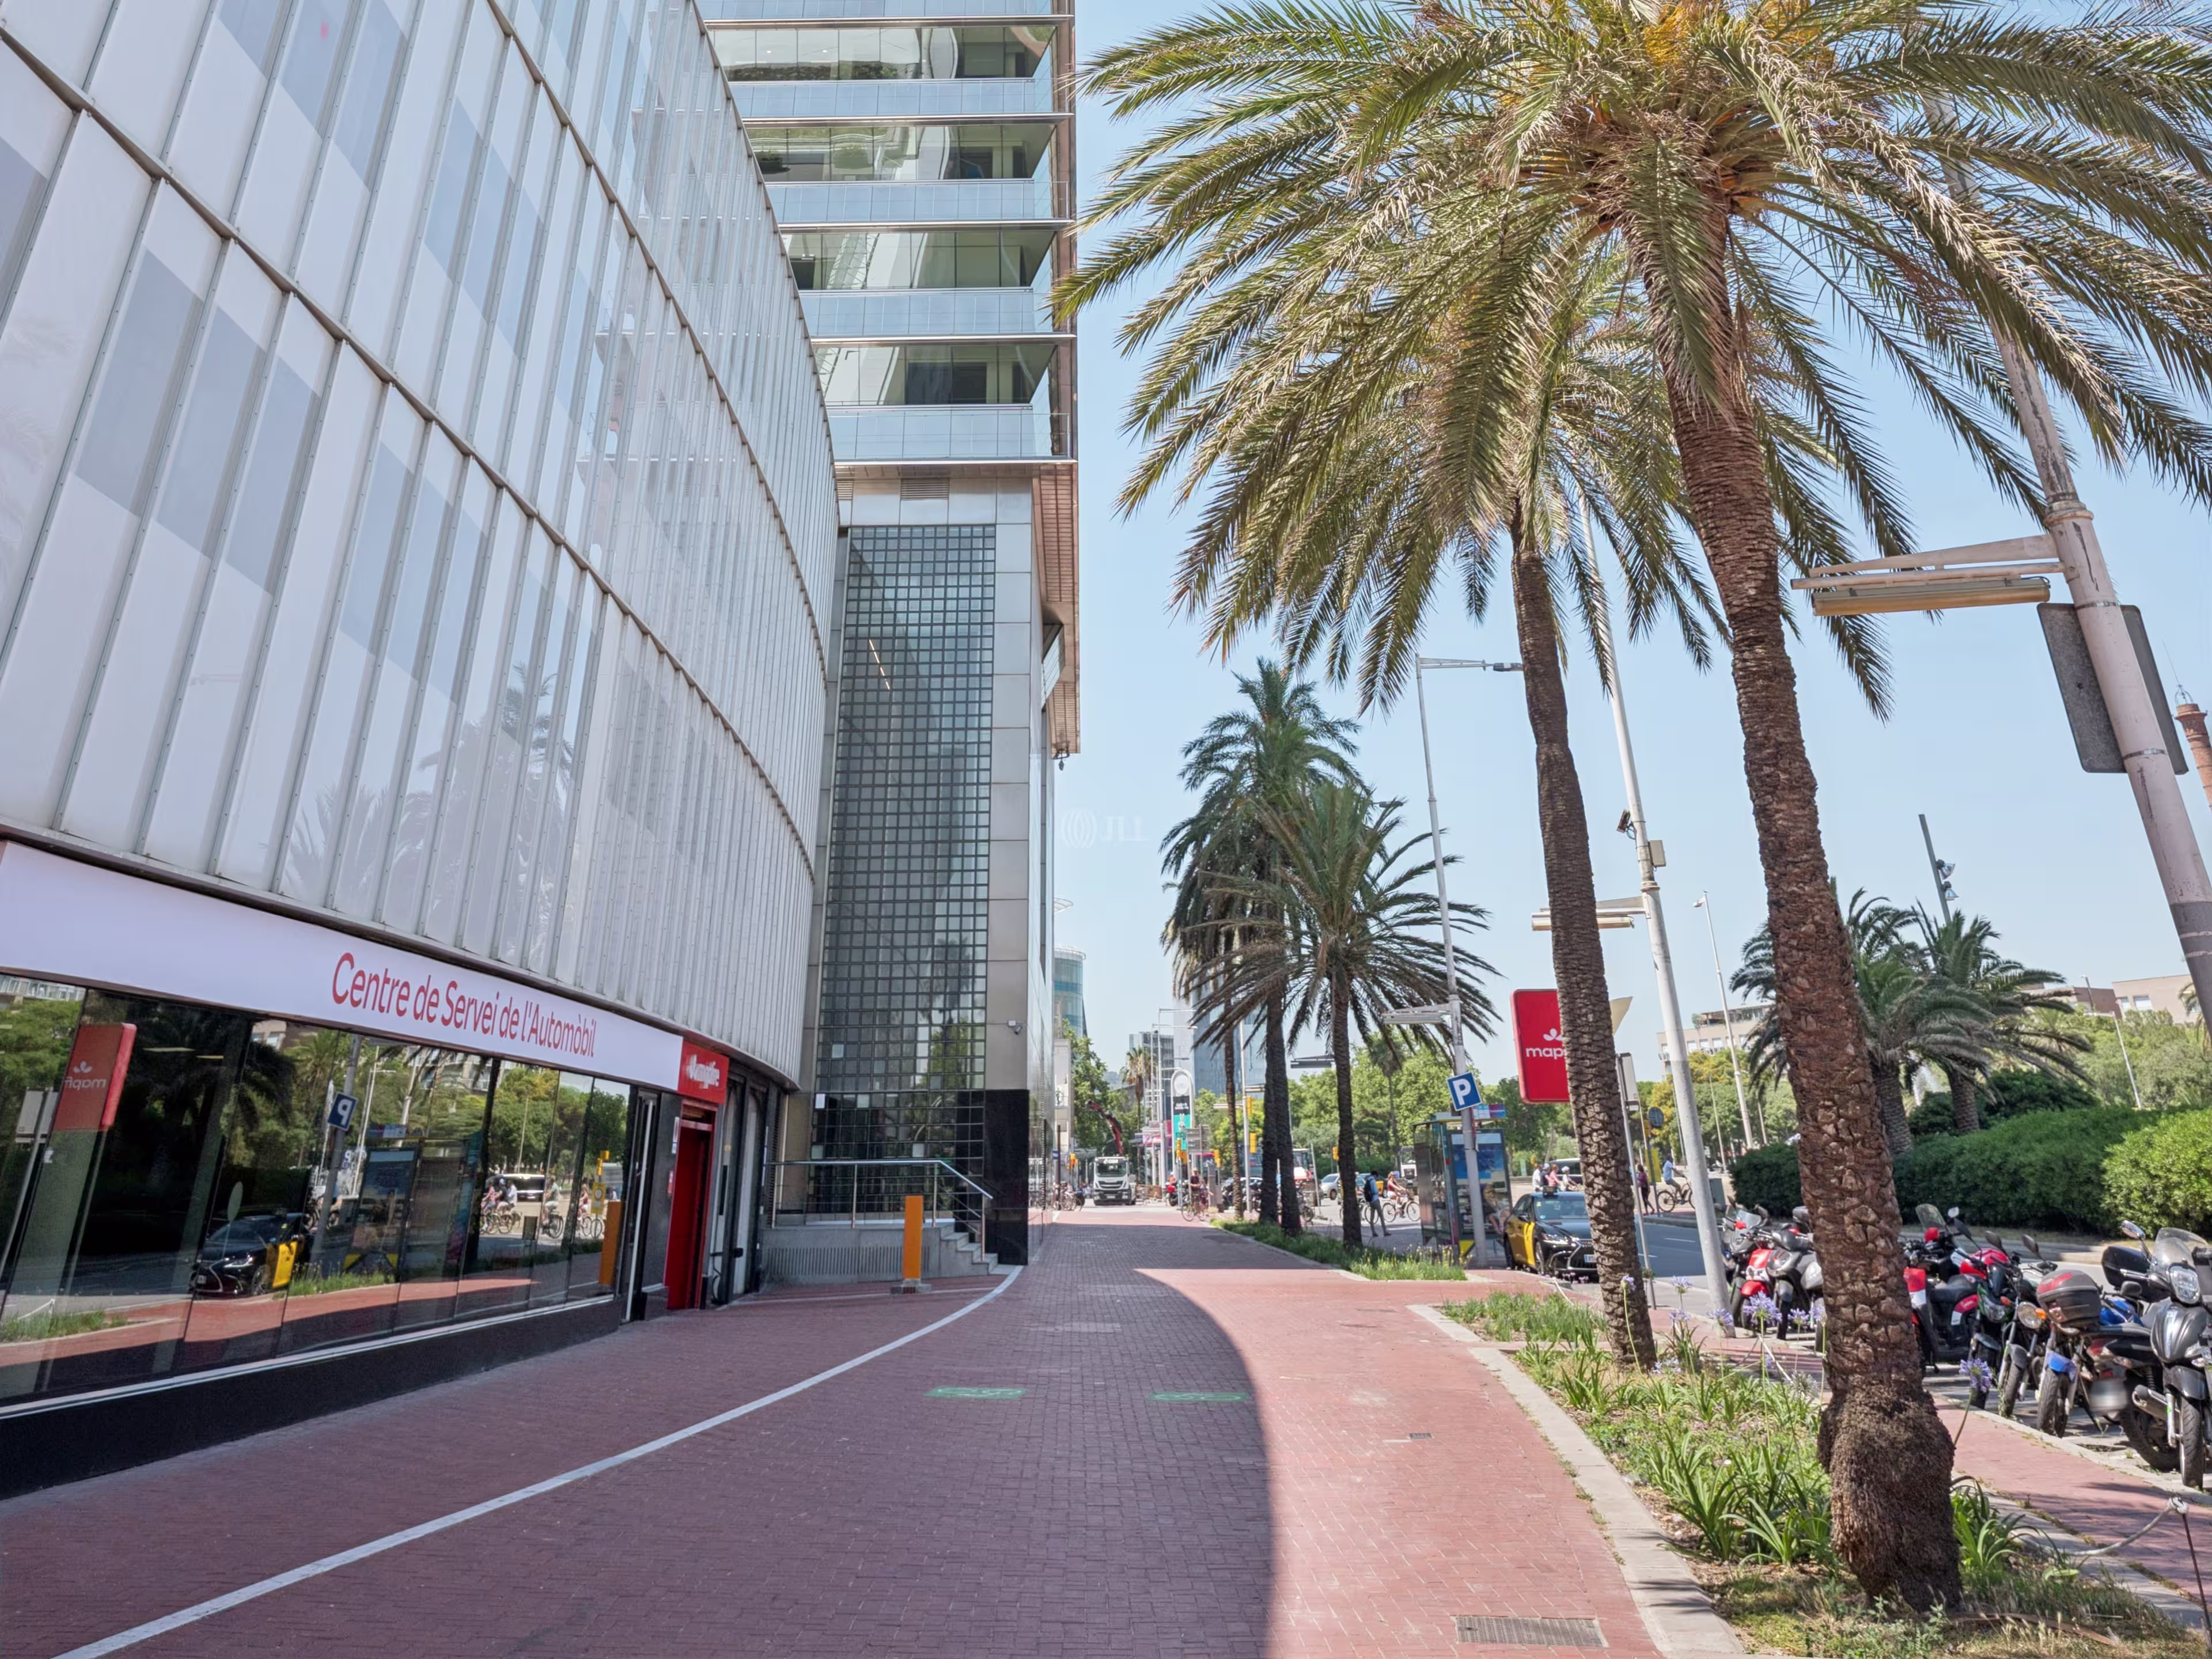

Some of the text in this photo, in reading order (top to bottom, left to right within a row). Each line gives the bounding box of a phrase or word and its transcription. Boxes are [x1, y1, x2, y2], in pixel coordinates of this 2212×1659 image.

[332, 952, 597, 1058] Centre de Servei de l'Automòbil
[1452, 1078, 1471, 1105] P
